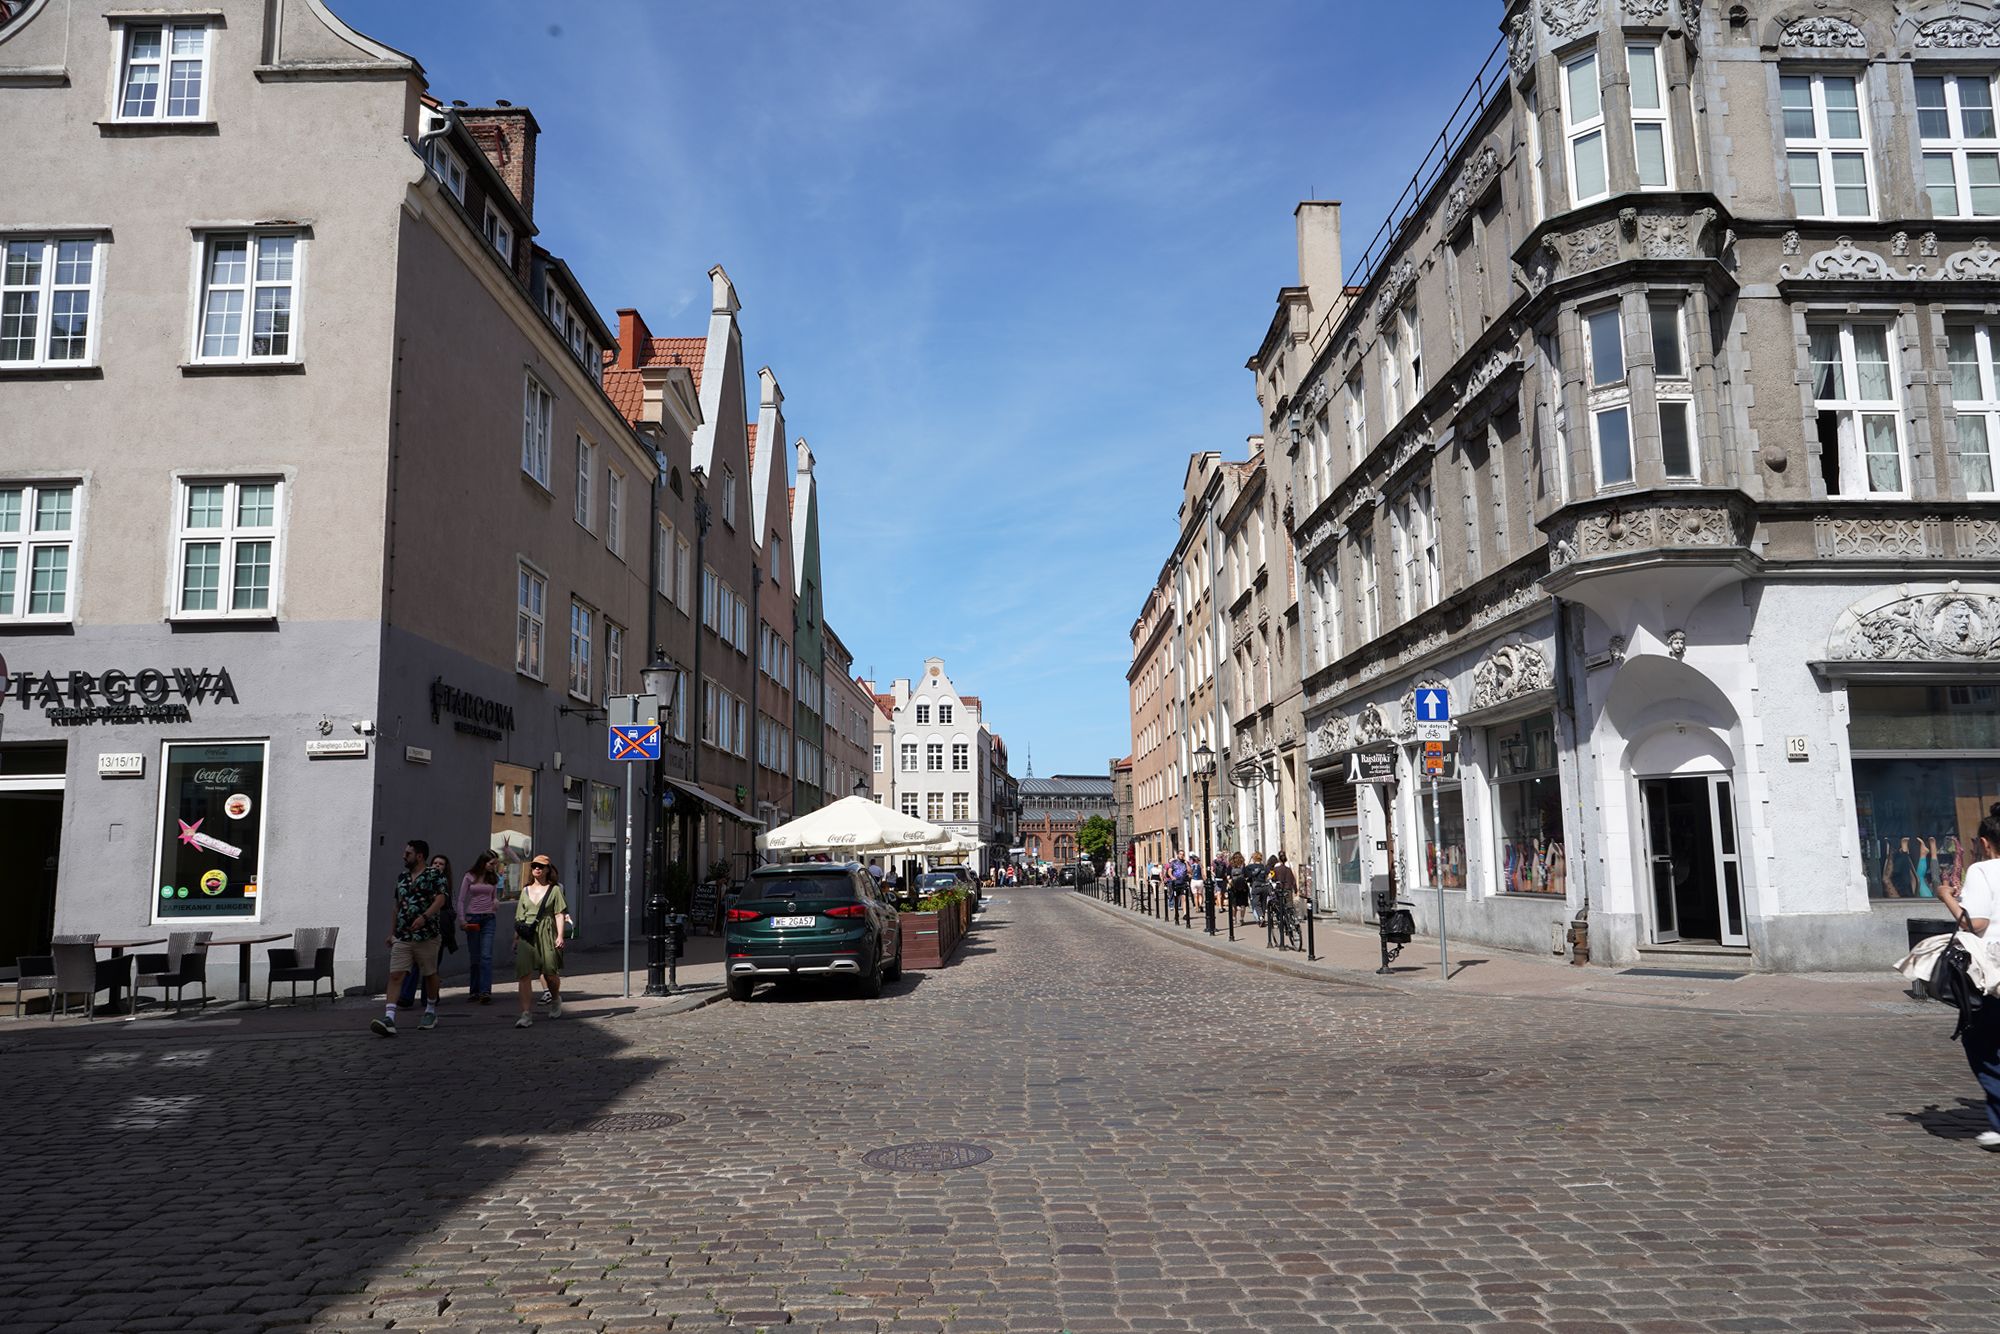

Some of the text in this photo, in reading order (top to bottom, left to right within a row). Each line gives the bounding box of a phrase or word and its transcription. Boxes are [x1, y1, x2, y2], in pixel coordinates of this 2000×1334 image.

[10, 666, 236, 701] TARGOWA
[96, 704, 141, 717] PIZZA
[146, 703, 188, 716] PASTA
[445, 685, 515, 731] TARGOWA
[343, 741, 362, 749] Ducha
[1791, 738, 1805, 751] 19
[100, 756, 141, 768] 13/15/17
[1361, 752, 1391, 765] Rajstopki
[162, 903, 254, 911] ZAPIEKANKI BURGERY
